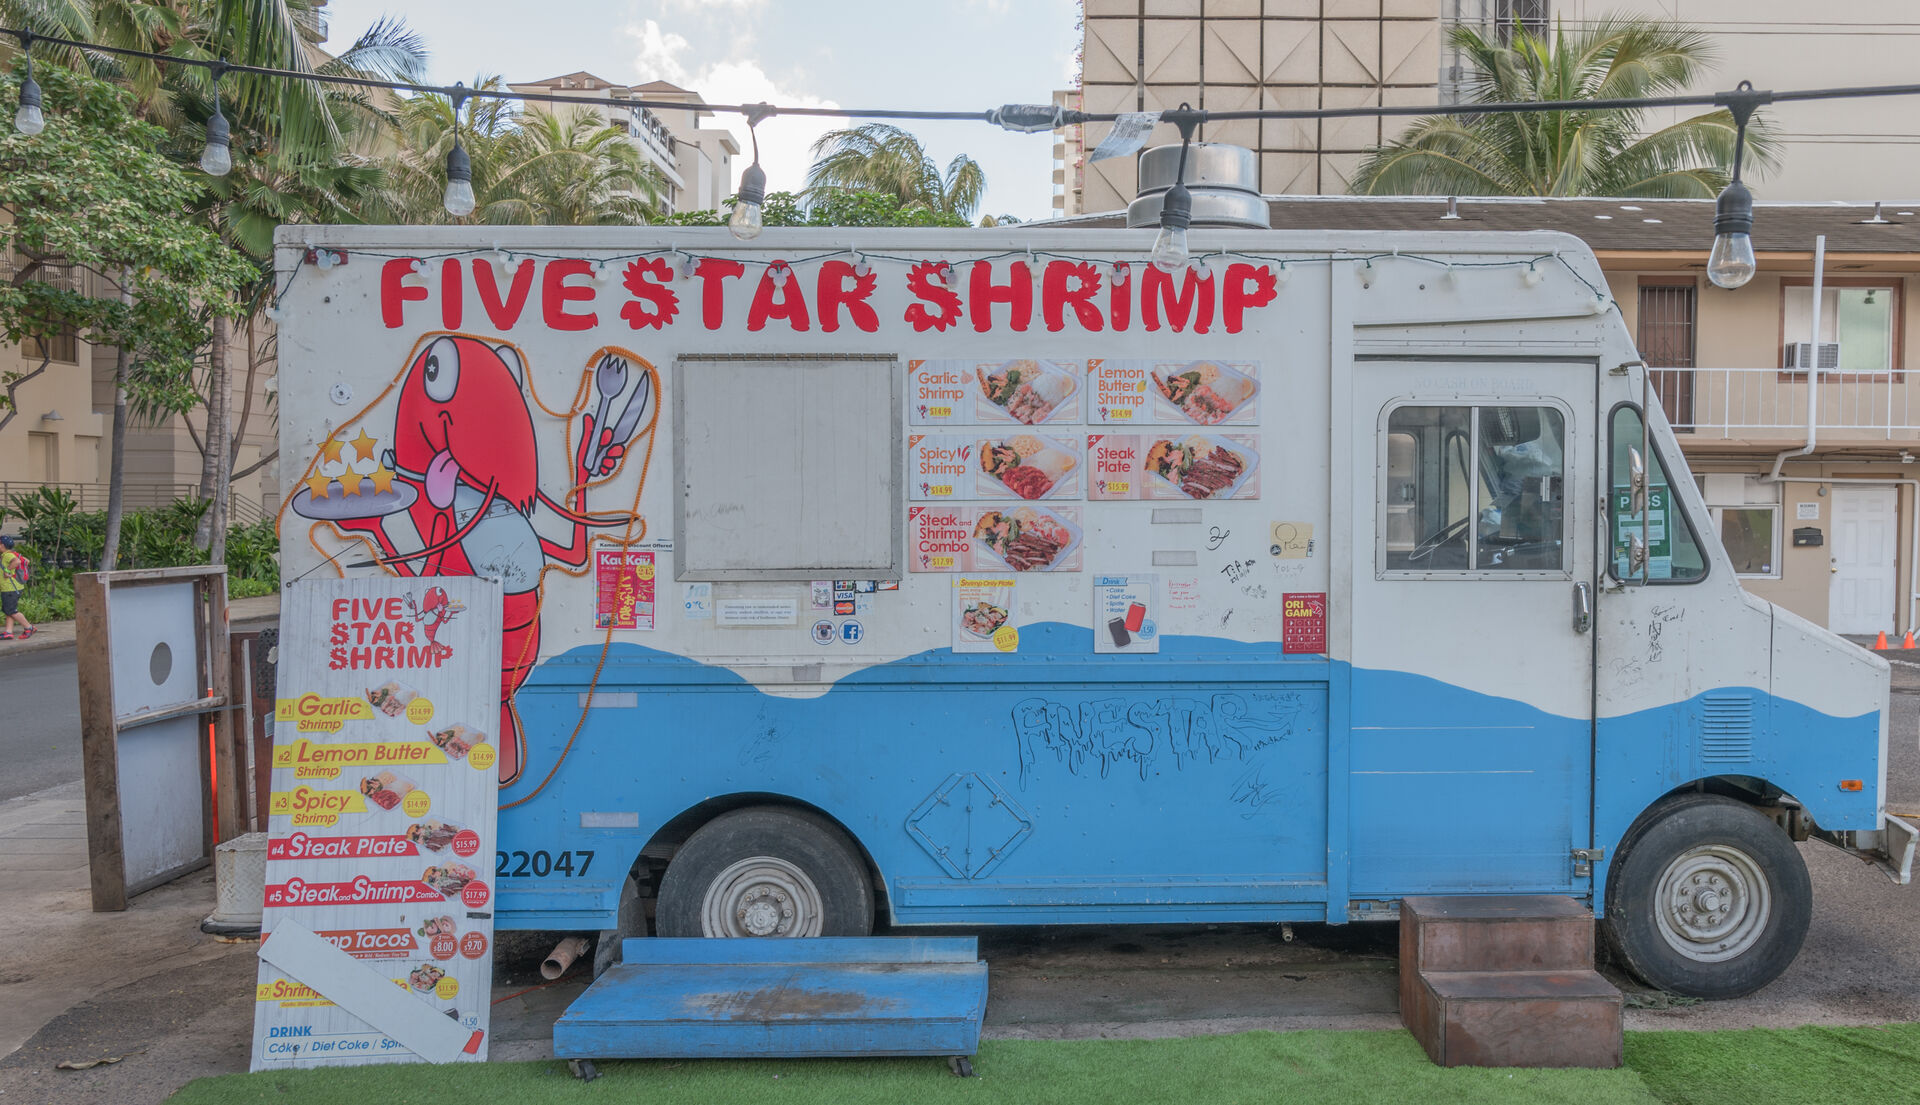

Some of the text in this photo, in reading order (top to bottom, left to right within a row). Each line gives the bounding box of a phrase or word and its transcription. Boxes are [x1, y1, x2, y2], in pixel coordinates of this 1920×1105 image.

[381, 256, 1279, 334] FIVE STAR SHRIMP
[918, 372, 958, 384] Garlic
[1098, 367, 1144, 378] Lemon
[1098, 380, 1136, 392] Butter
[919, 387, 964, 402] Shrimp
[1098, 392, 1144, 408] Shrimp
[920, 447, 956, 462] Spicy
[1097, 447, 1136, 460] Steak
[920, 462, 966, 477] Shrimp
[1098, 461, 1131, 472] Plate
[1108, 482, 1128, 491] $15.99
[920, 514, 958, 526] Steak
[920, 527, 967, 542] Shrimp
[919, 540, 970, 552] Combo
[932, 558, 954, 566] $17.99
[961, 578, 982, 587] Shrimp
[332, 598, 404, 621] FIVE
[1286, 600, 1304, 609] ORI
[1286, 608, 1312, 617] GAMI
[330, 621, 415, 646] STAR
[328, 646, 454, 670] SHRIMP
[281, 695, 362, 716] #1 Garlic
[299, 719, 341, 732] Shrimp
[278, 742, 431, 762] #2 Lemon Butter
[472, 752, 494, 760] $14.99
[297, 766, 340, 779] Shrimp
[275, 788, 352, 812] #3 Spicy
[406, 800, 428, 808] $14.99
[294, 814, 336, 826] Shrimp
[272, 834, 408, 856] #4 Steak Plate
[456, 840, 477, 848] $15.99
[496, 850, 594, 878] 22047
[270, 878, 440, 904] #5 Steak and Shrimp Combo
[466, 890, 486, 899] $17.99
[356, 931, 410, 948] Tacos
[464, 940, 482, 951] $9.70
[434, 942, 454, 952] $8.00
[270, 1026, 312, 1038] DRINK
[269, 1042, 299, 1054] Coke
[312, 1040, 336, 1052] Diet
[338, 1038, 370, 1050] Coke
